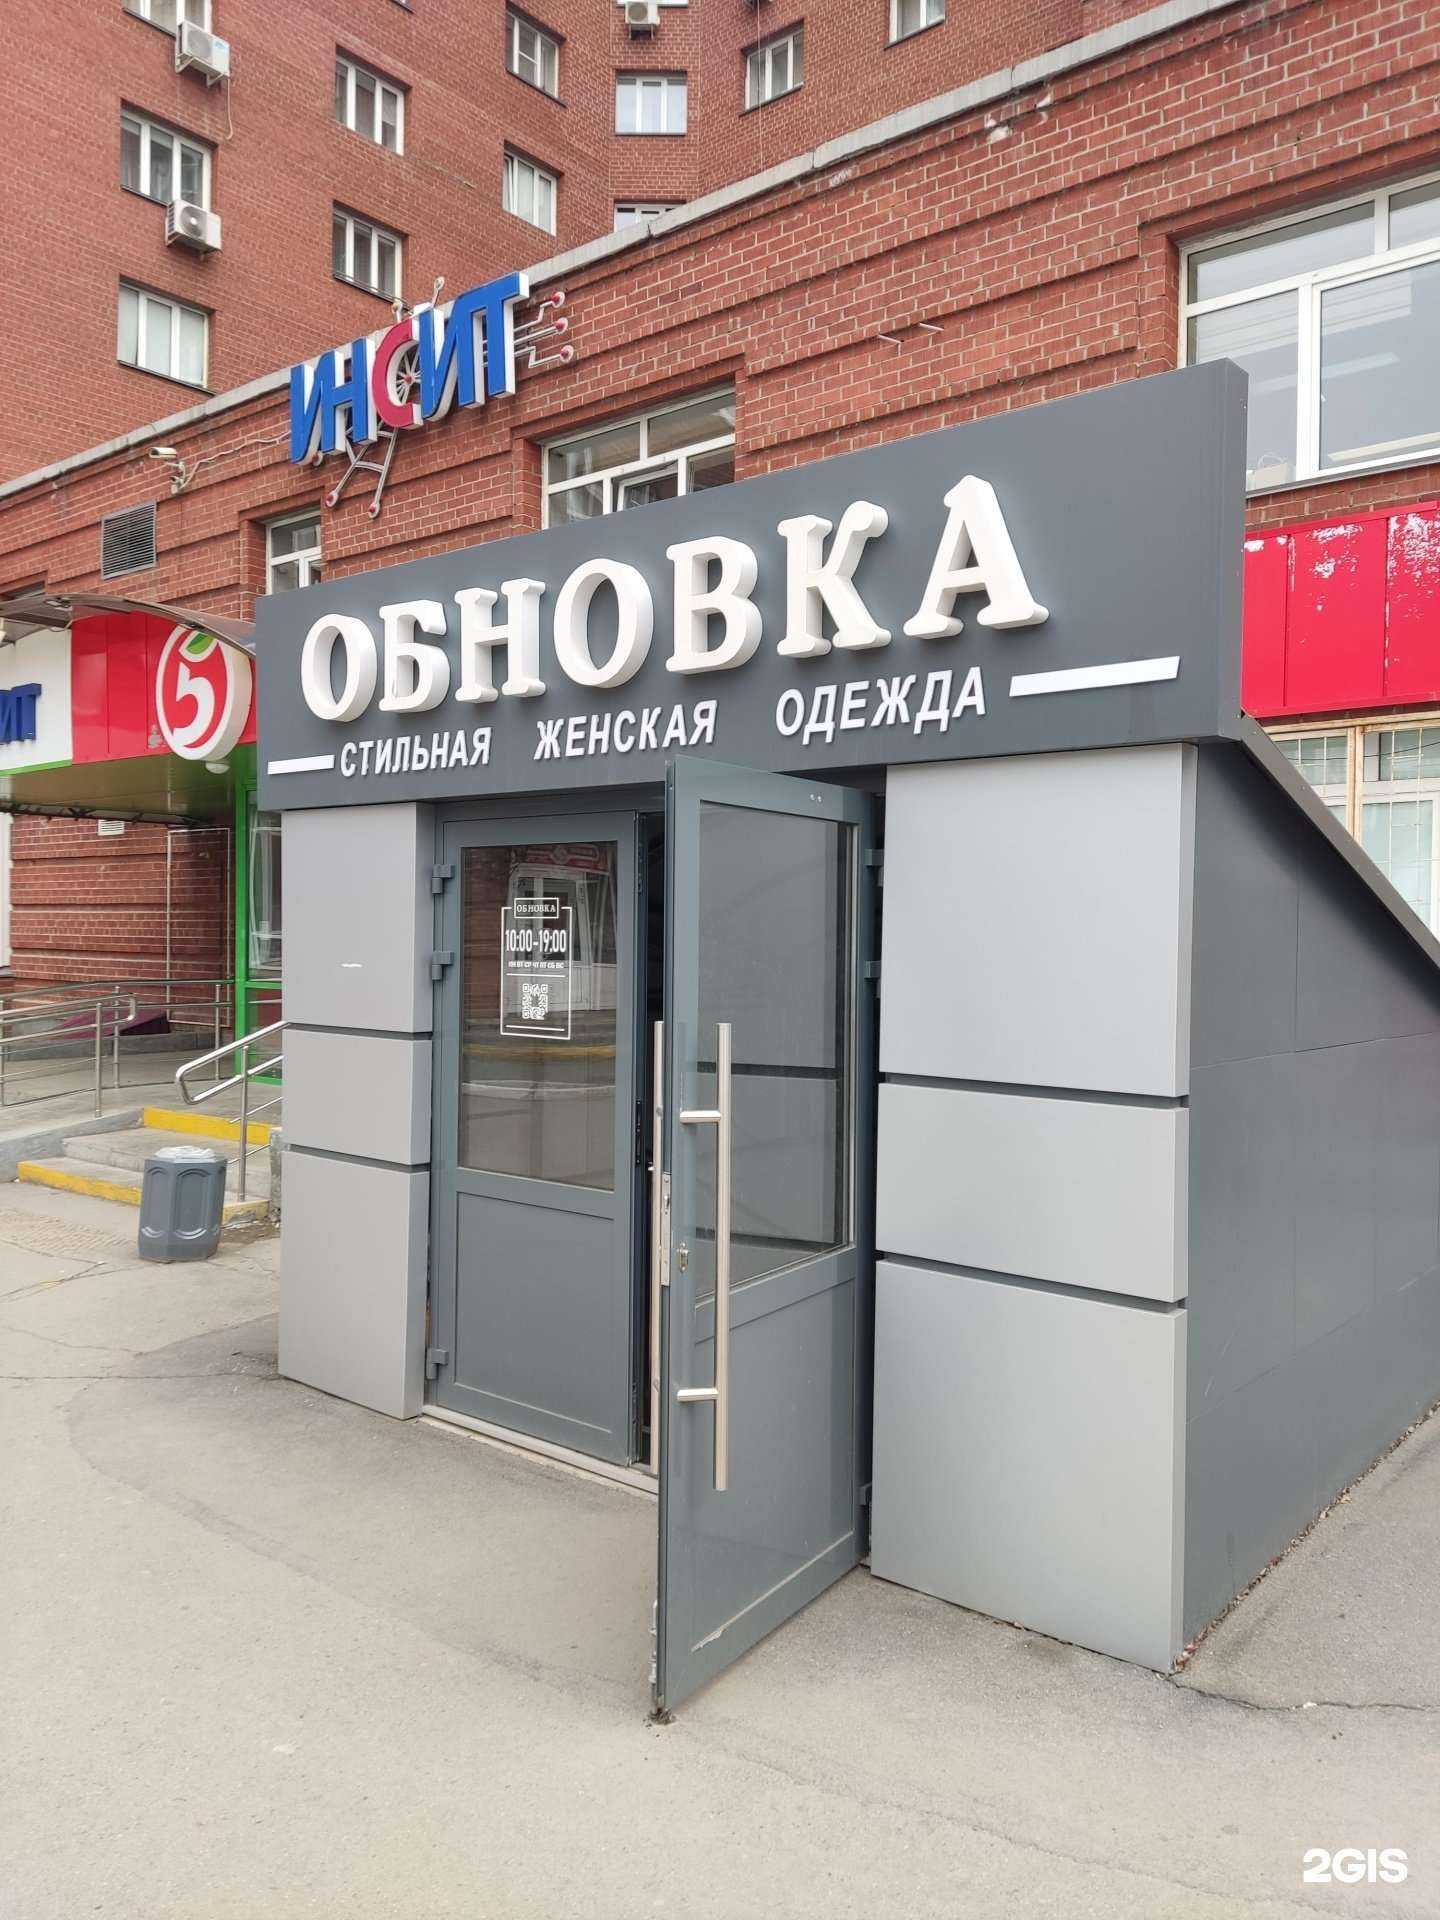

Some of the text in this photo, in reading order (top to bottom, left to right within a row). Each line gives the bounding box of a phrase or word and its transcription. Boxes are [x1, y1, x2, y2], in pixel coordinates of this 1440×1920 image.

[289, 272, 530, 466] ИНСИТ
[300, 474, 1050, 723] ОБНОВКА
[339, 666, 987, 778] СТИЛЬНАЯ ЖЕНСКАЯ ОДЕЖДА
[505, 929, 567, 952] 10:00-19:00
[516, 904, 556, 913] ОБНОВКА
